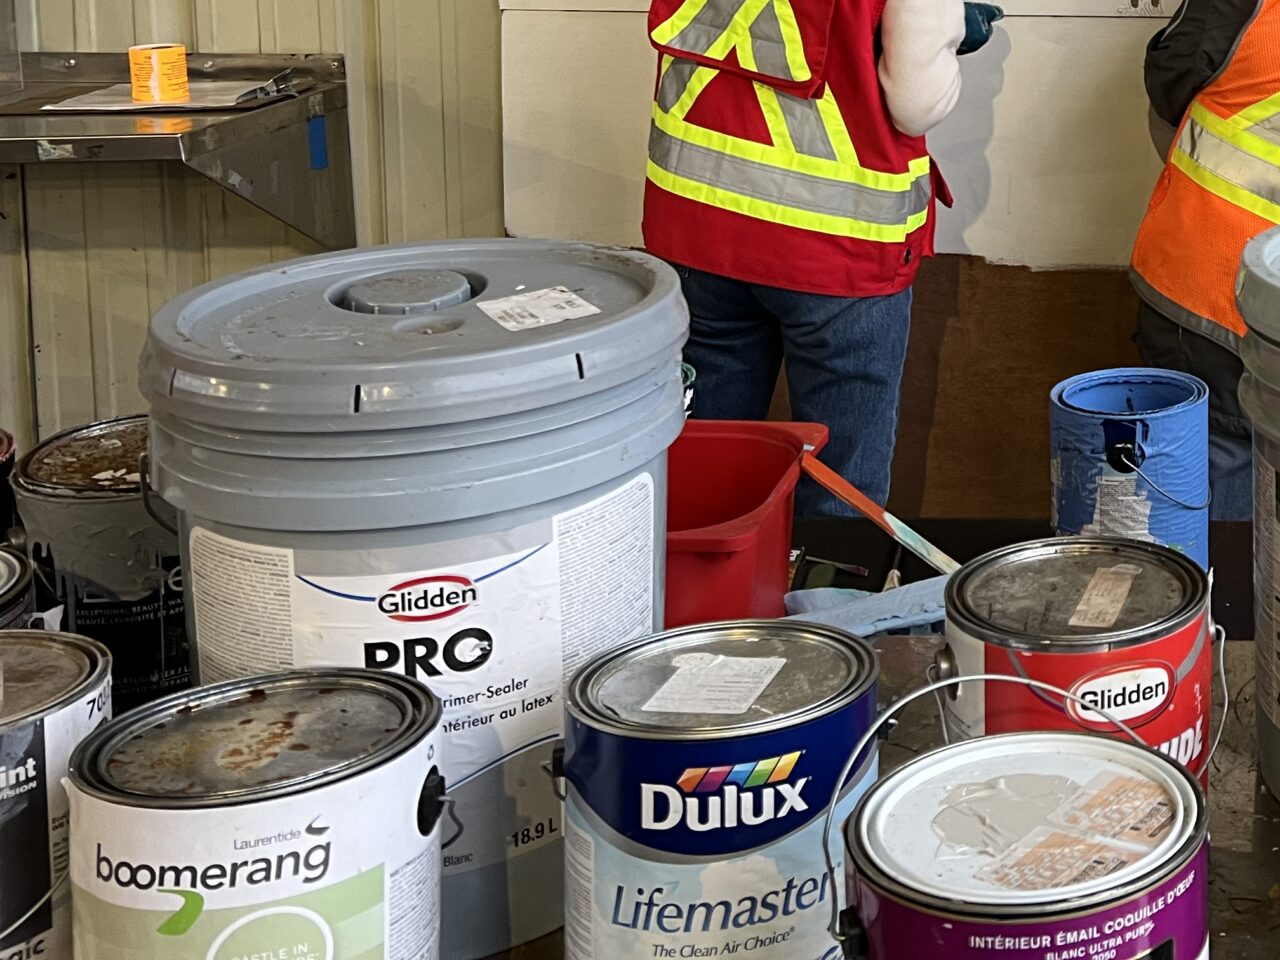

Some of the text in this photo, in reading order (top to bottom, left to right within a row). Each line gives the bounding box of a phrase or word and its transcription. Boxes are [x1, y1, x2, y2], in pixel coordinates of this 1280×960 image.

[377, 586, 478, 615] Glidden
[364, 627, 493, 679] PRO
[443, 677, 529, 709] rimer-Sealer
[500, 706, 517, 721] au
[522, 695, 553, 714] latex
[1079, 680, 1166, 712] Glidden
[640, 777, 809, 831] Dulux
[233, 829, 302, 852] Laurentide
[512, 818, 559, 848] 18.9 L
[96, 841, 332, 890] boomerang
[443, 852, 474, 868] Blanc
[611, 871, 833, 934] Lifemaster
[968, 934, 1051, 950] INTÉRIEUR
[1056, 926, 1101, 946] ÉMAIL
[1104, 896, 1165, 935] COQUILLE
[231, 943, 308, 960] ASTLE IN
[652, 931, 790, 958] The Clean Air Choice
[1047, 946, 1086, 960] BLANC
[1089, 936, 1123, 954] ULTRA
